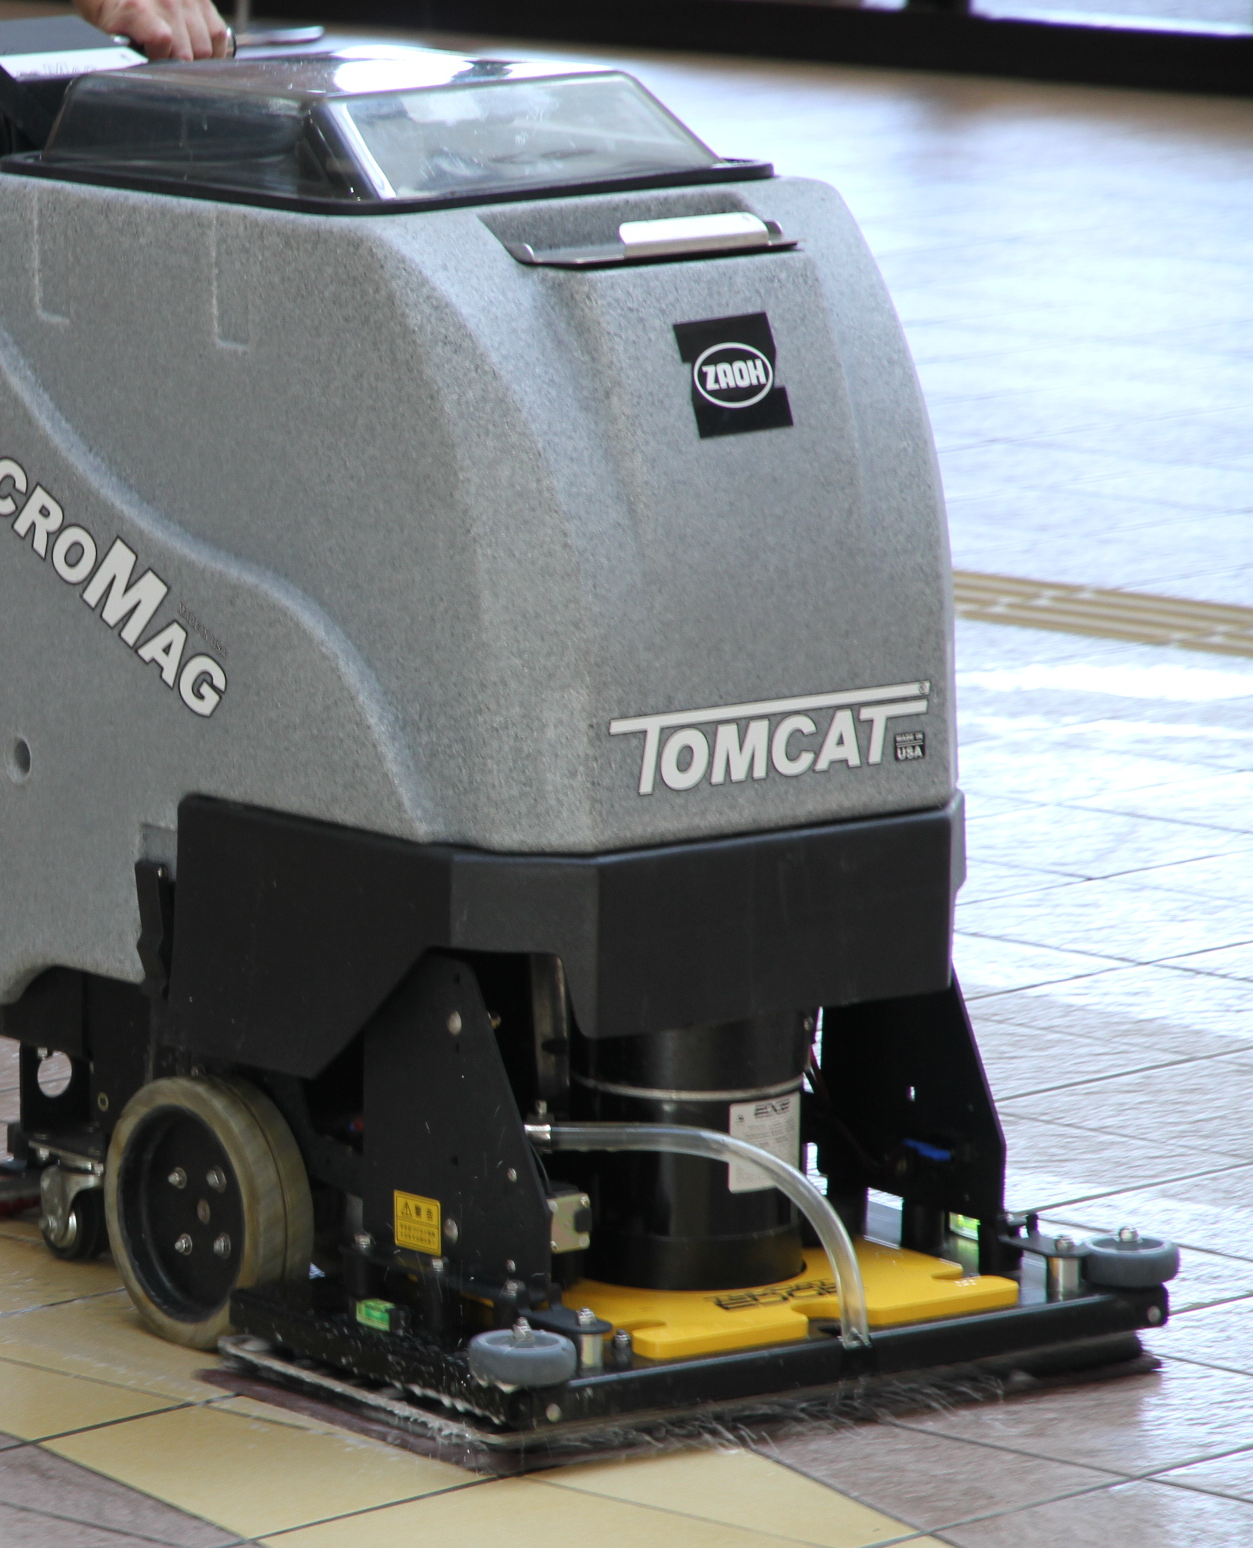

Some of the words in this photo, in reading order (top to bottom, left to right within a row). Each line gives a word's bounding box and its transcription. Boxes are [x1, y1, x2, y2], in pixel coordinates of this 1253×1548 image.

[702, 358, 767, 391] ZAOH
[609, 680, 931, 796] TOMCAT
[896, 733, 914, 742] MADE
[897, 744, 924, 760] USA
